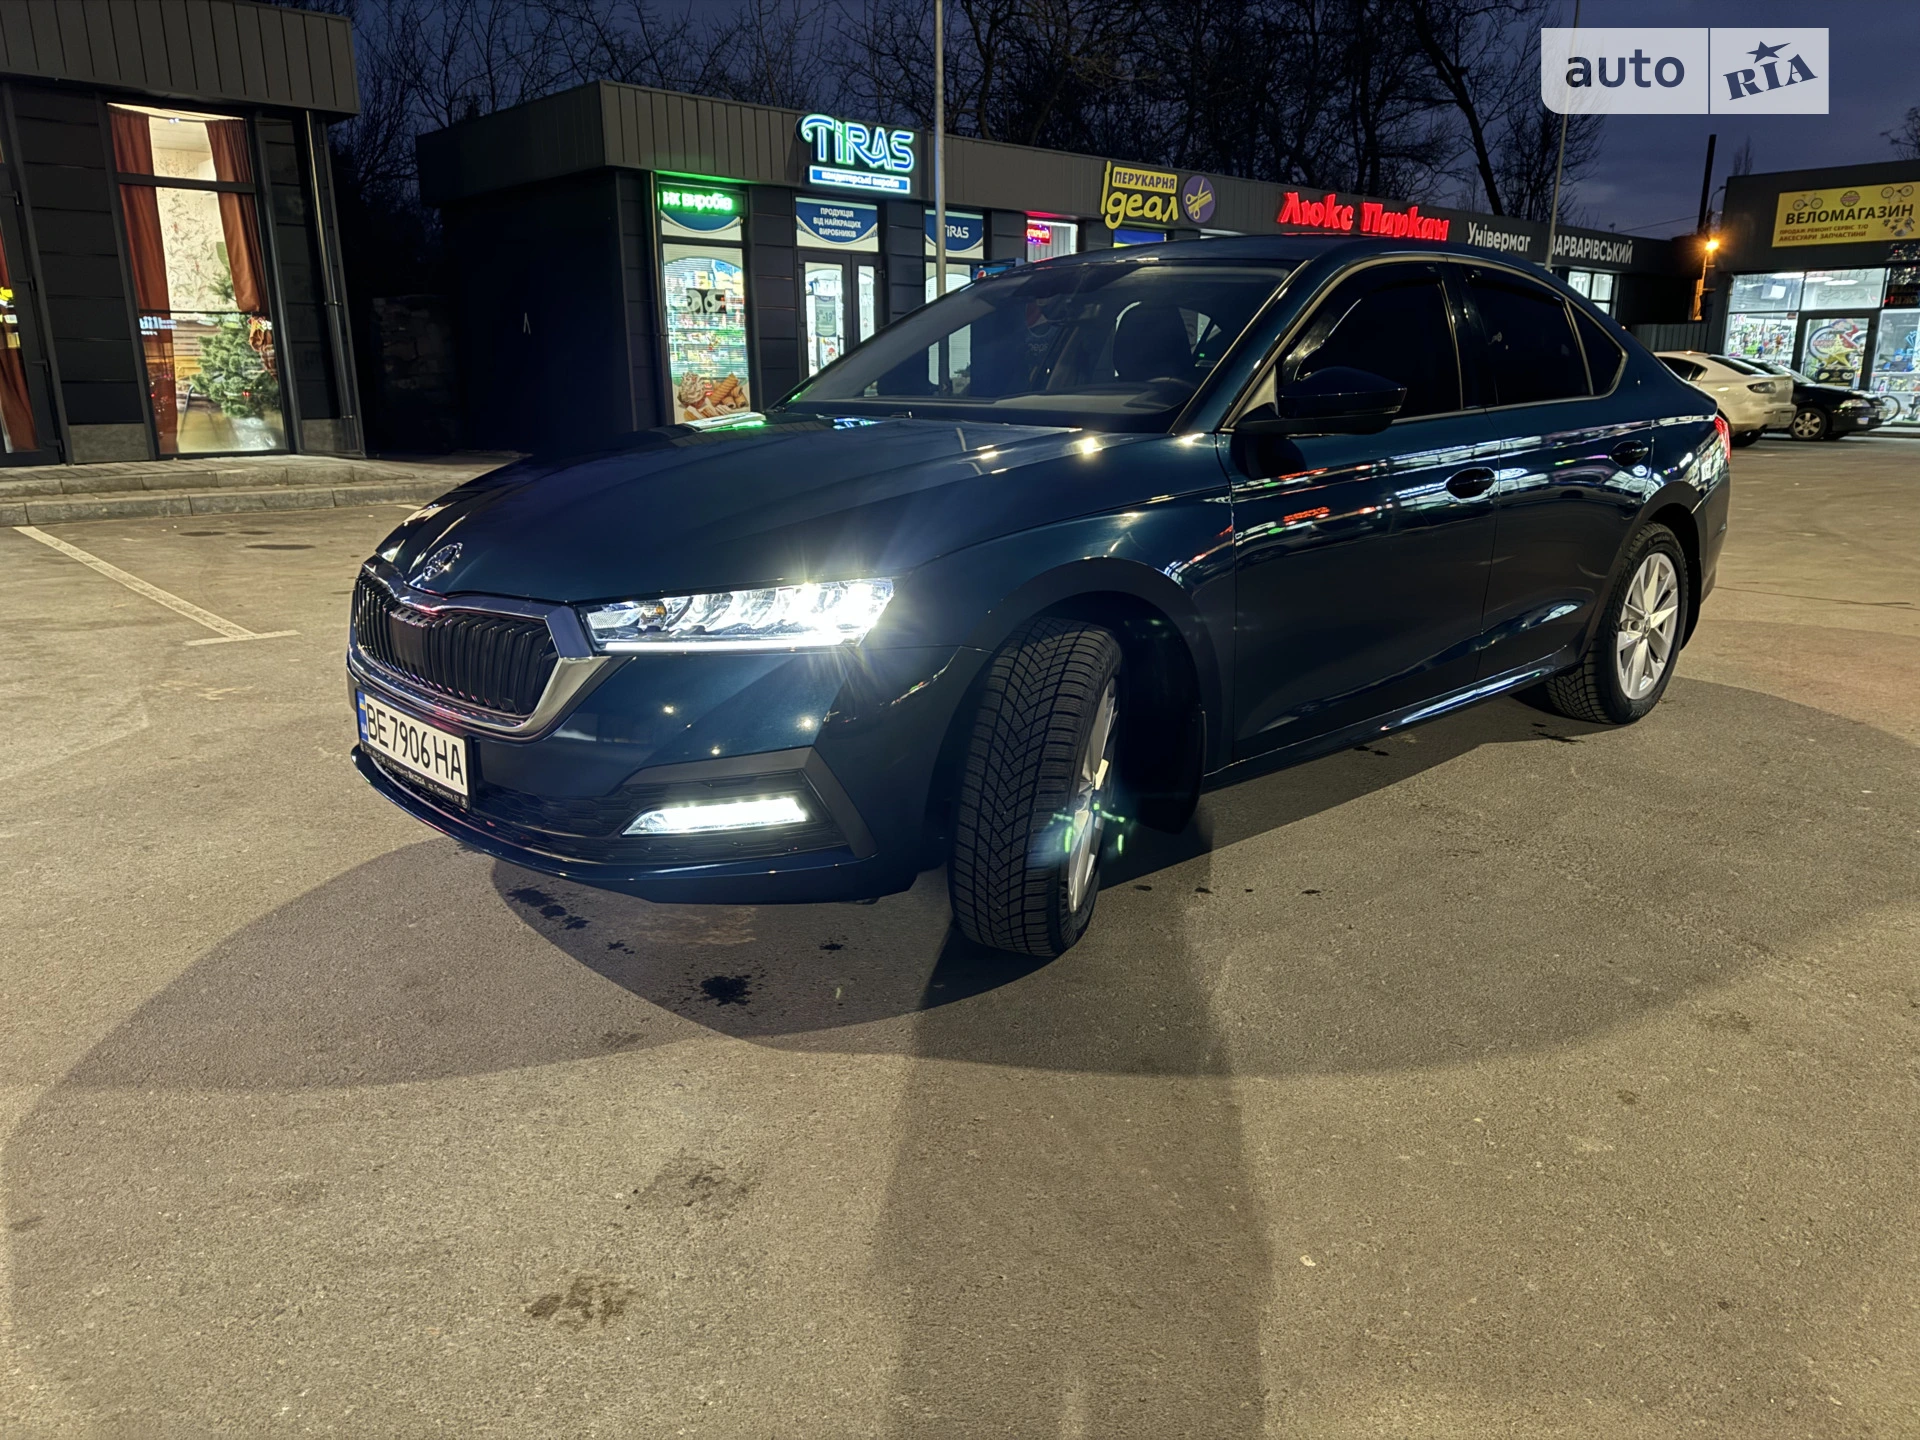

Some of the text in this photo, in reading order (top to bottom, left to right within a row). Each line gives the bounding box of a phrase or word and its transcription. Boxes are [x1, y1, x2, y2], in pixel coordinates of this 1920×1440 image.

[1114, 171, 1175, 189] ПЕРУКАРНЯ
[820, 207, 854, 218] ПРОДУКЦІЯ
[1277, 191, 1450, 241] Люкс Паркан
[1785, 204, 1914, 225] ВЕЛОМАГАЗИН
[813, 217, 861, 229] ВІД НАЙКРАЩИХ
[1833, 224, 1855, 232] СЕРВІС
[819, 227, 857, 238] ВИРОБНИКІВ
[1467, 221, 1531, 252] Універмаг
[1820, 231, 1867, 240] ЗАПЧАСТИНИ
